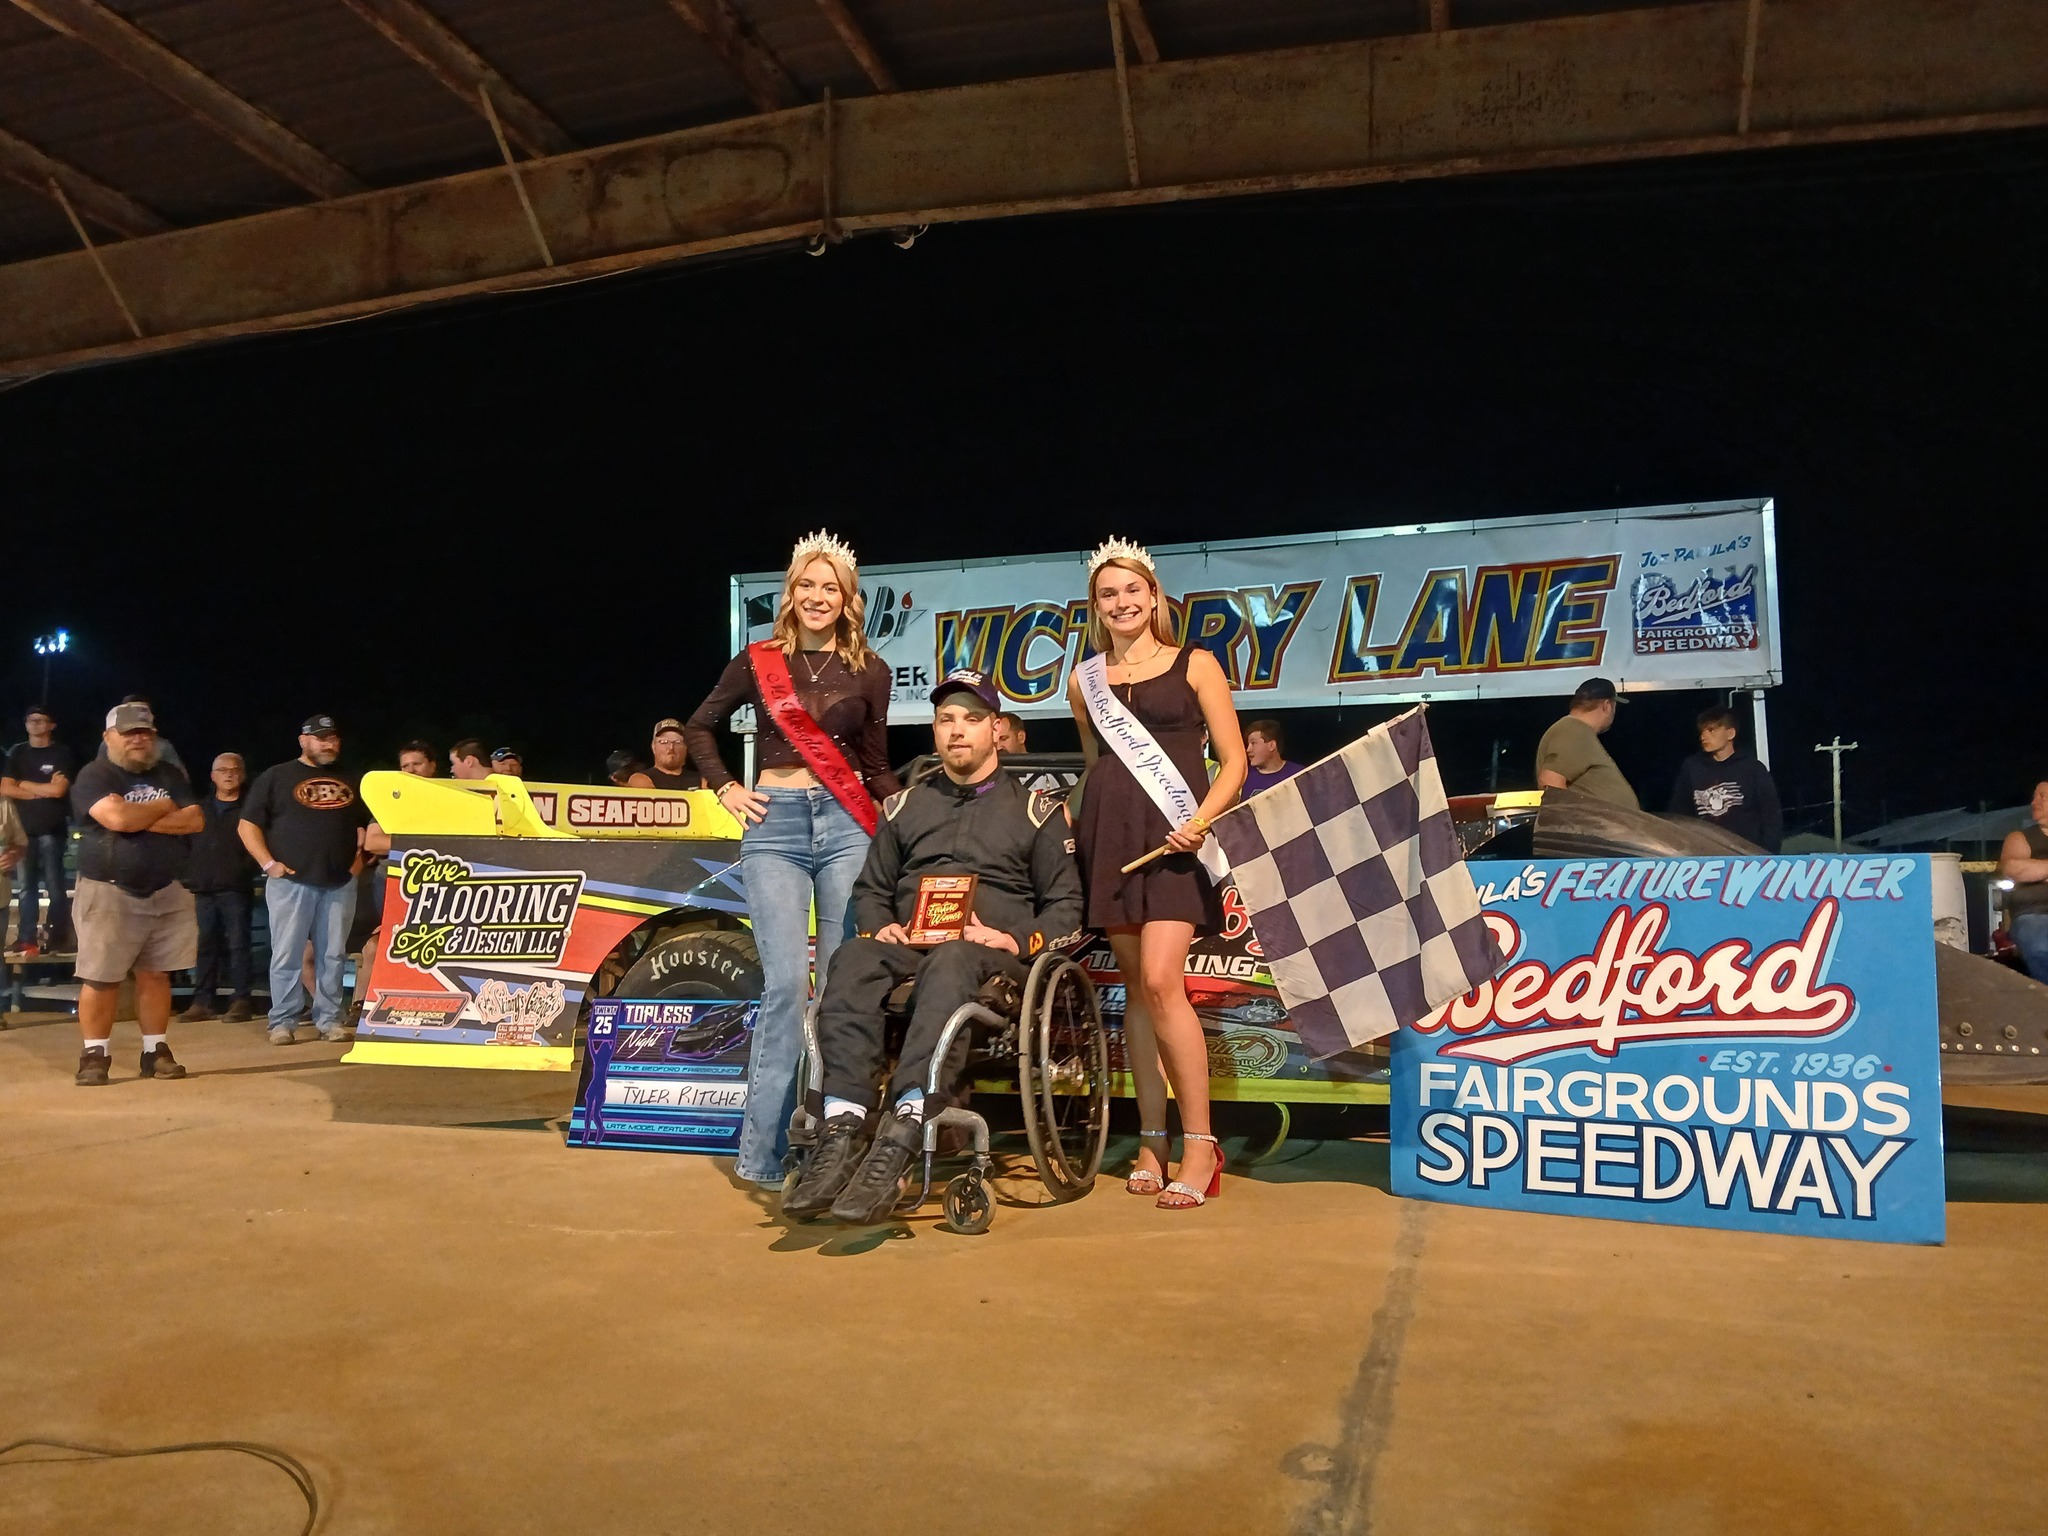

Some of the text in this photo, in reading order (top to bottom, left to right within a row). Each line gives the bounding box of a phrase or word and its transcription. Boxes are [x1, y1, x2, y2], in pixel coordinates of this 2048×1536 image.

[1637, 566, 1754, 624] Bedford
[1328, 553, 1622, 684] LANE
[1637, 625, 1753, 638] FAIRGROUNDS
[1637, 635, 1752, 652] SPEEDWAY
[1092, 690, 1150, 751] Bedford
[571, 798, 688, 824] SEAFOOD
[1543, 861, 1727, 908] FEATURE
[1722, 858, 1917, 908] WINNER
[411, 882, 575, 925] FLOORING
[444, 926, 561, 954] & DESIGN LLC
[650, 949, 745, 981] Hoosier
[380, 996, 462, 1013] PENSKE
[625, 1004, 694, 1024] TOPLESS
[593, 1016, 613, 1034] 25
[616, 1024, 670, 1059] Night
[641, 1065, 681, 1073] BEDFORD
[681, 1066, 740, 1074] FAIRGROUNDS
[1710, 1050, 1880, 1079] EST. 1936
[624, 1085, 748, 1107] TYLER RITCHEY
[1418, 1062, 1911, 1136] FAIRGROUNDS
[1416, 1110, 1917, 1221] SPEEDWAY
